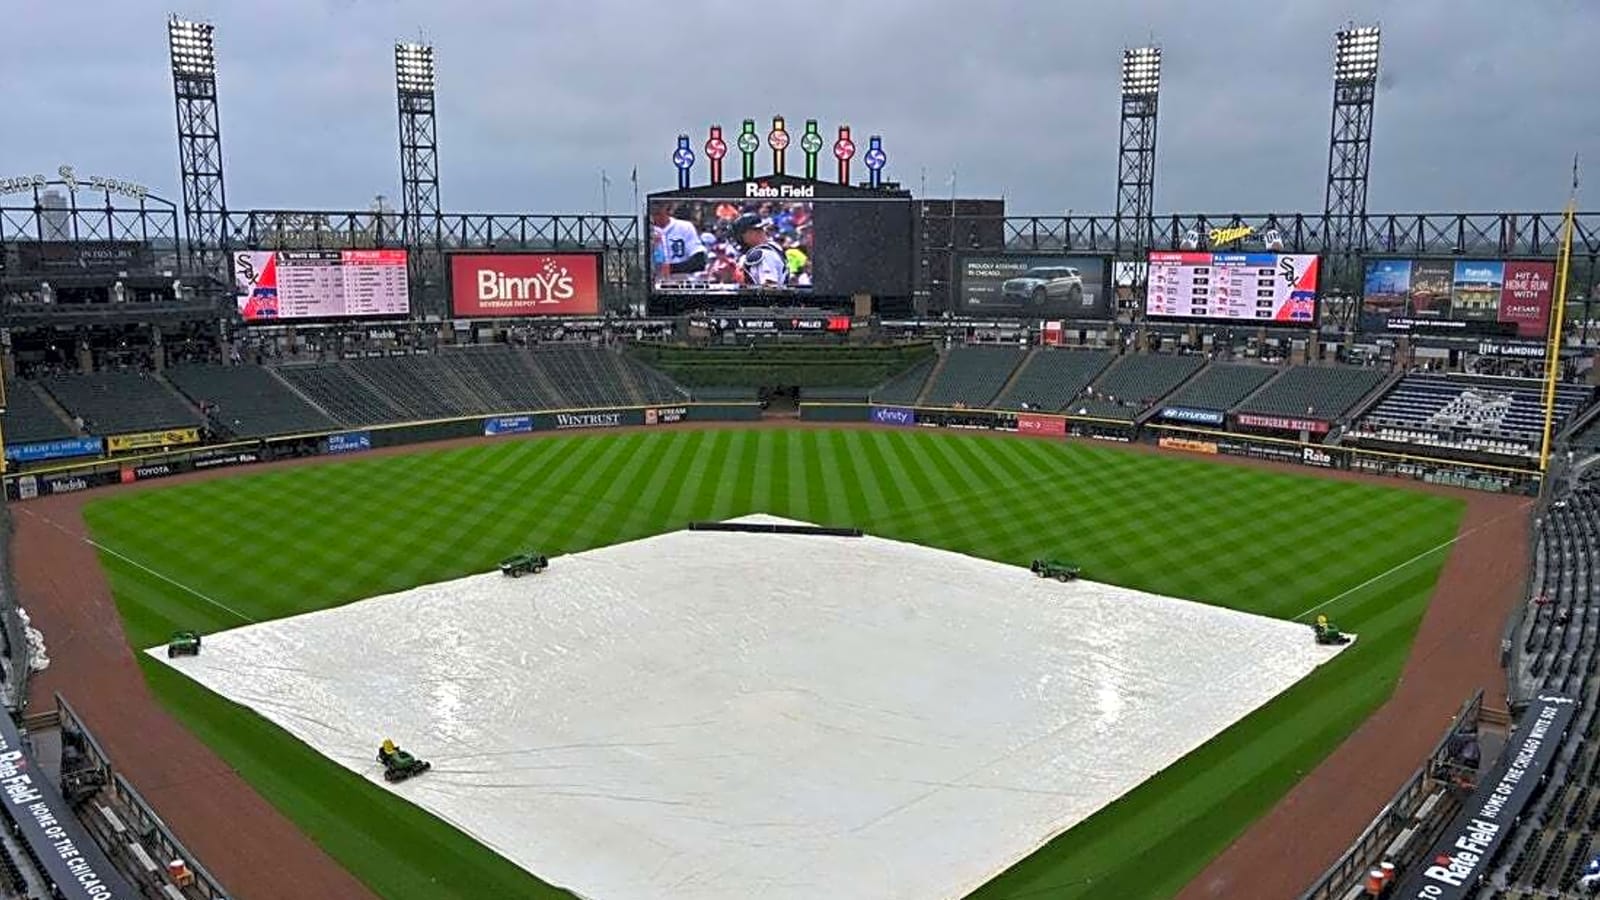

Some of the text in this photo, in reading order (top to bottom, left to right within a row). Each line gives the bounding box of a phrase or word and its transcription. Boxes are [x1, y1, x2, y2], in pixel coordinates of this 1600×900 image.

[89, 175, 149, 200] ZONE
[746, 181, 814, 197] Rate Field
[1209, 226, 1256, 246] Miller
[1515, 272, 1540, 280] HIT A
[1505, 280, 1549, 291] HOME RUN
[1501, 345, 1545, 356] LANDING
[557, 413, 620, 426] WINTRUST
[877, 409, 908, 424] xfinity
[1178, 411, 1218, 420] HYUNDAI
[1303, 447, 1332, 462] Rate
[137, 465, 170, 476] TOYOTA
[52, 479, 87, 493] Modelo
[1540, 706, 1558, 720] SOX
[1529, 719, 1552, 739] WHITE
[1512, 738, 1541, 769] CHICAGO
[1502, 768, 1525, 784] THE
[1, 773, 43, 805] Field
[1495, 782, 1514, 795] OF
[1480, 793, 1508, 819] HOME
[28, 802, 58, 828] HOME
[45, 826, 67, 840] OF
[1454, 818, 1500, 855] Field
[54, 838, 80, 859] THE
[1424, 853, 1480, 887] Rate
[66, 857, 112, 900] CHICAGO
